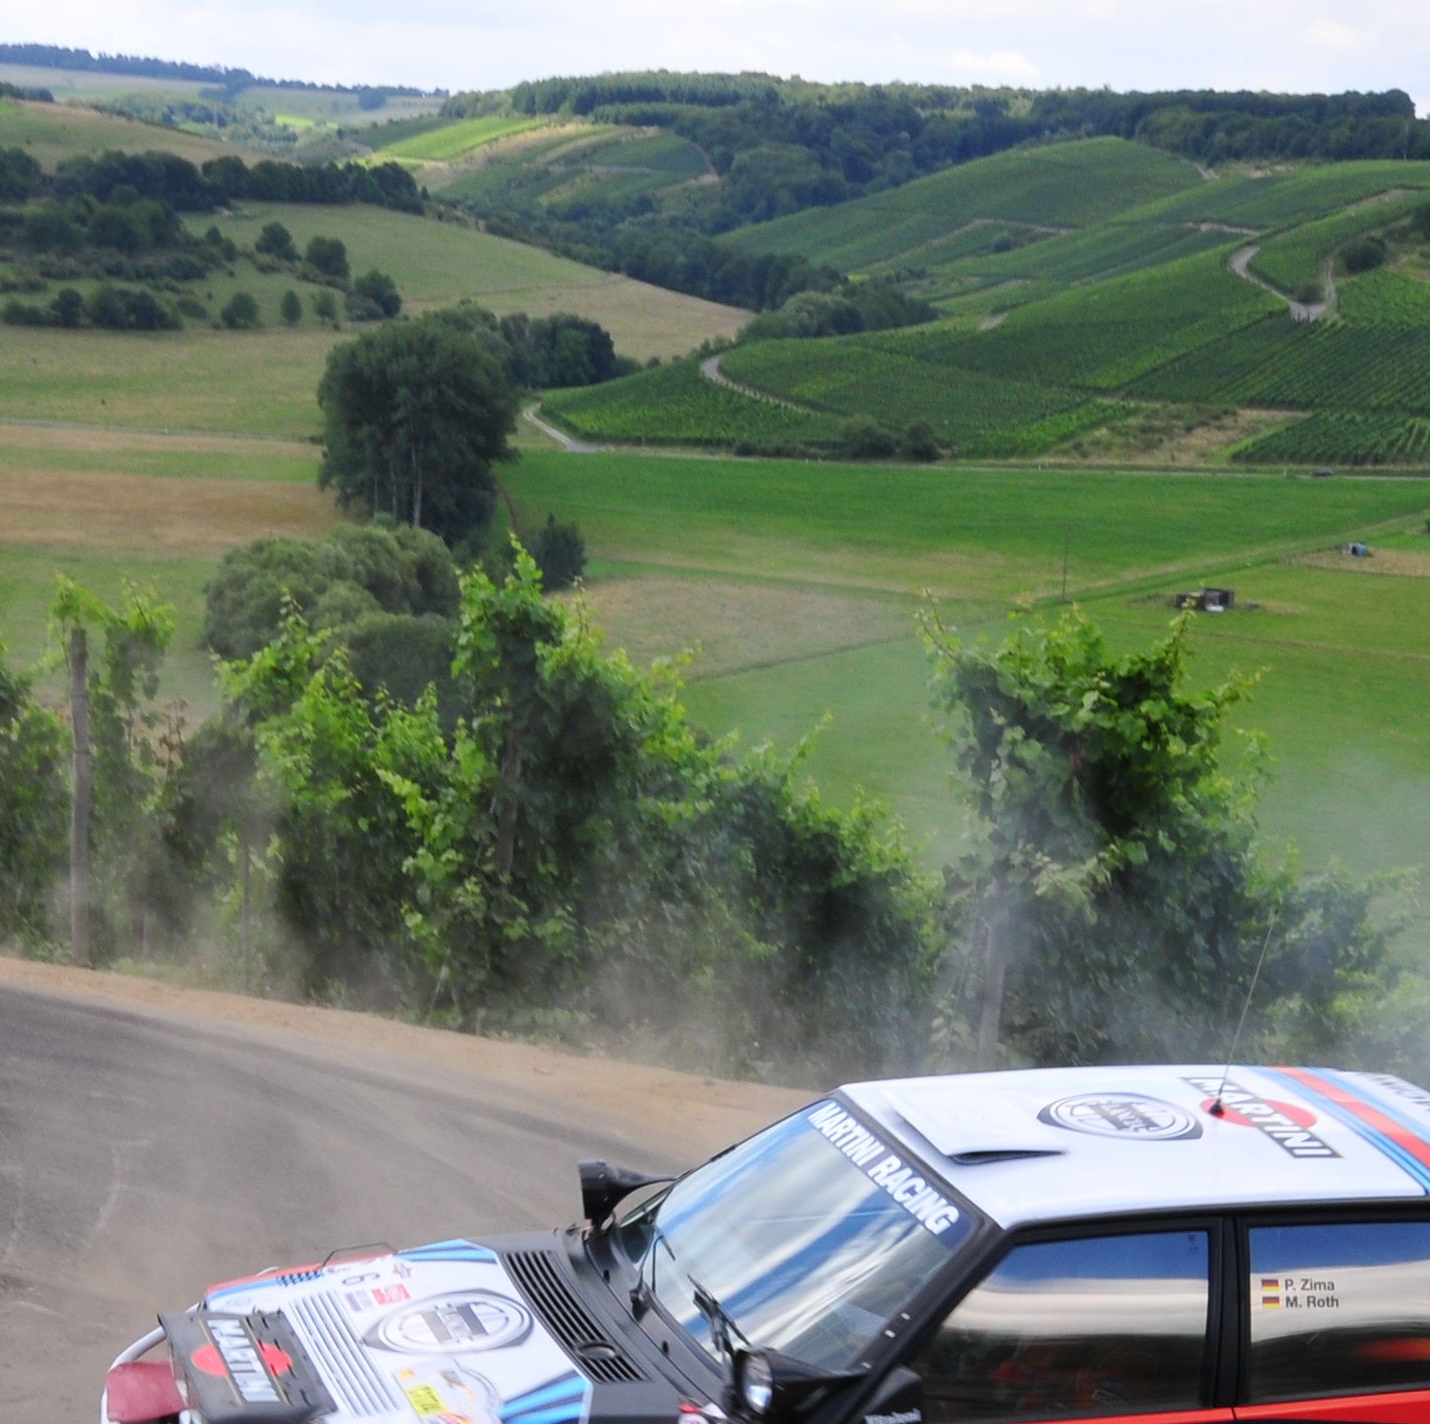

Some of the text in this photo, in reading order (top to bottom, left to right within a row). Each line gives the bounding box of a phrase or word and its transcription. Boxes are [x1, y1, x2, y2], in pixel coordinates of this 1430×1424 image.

[1185, 1078, 1334, 1157] MARTINI
[807, 1102, 960, 1236] MARTINI RACING
[1285, 1278, 1335, 1291] P. Zima
[1285, 1295, 1339, 1308] M. Roth
